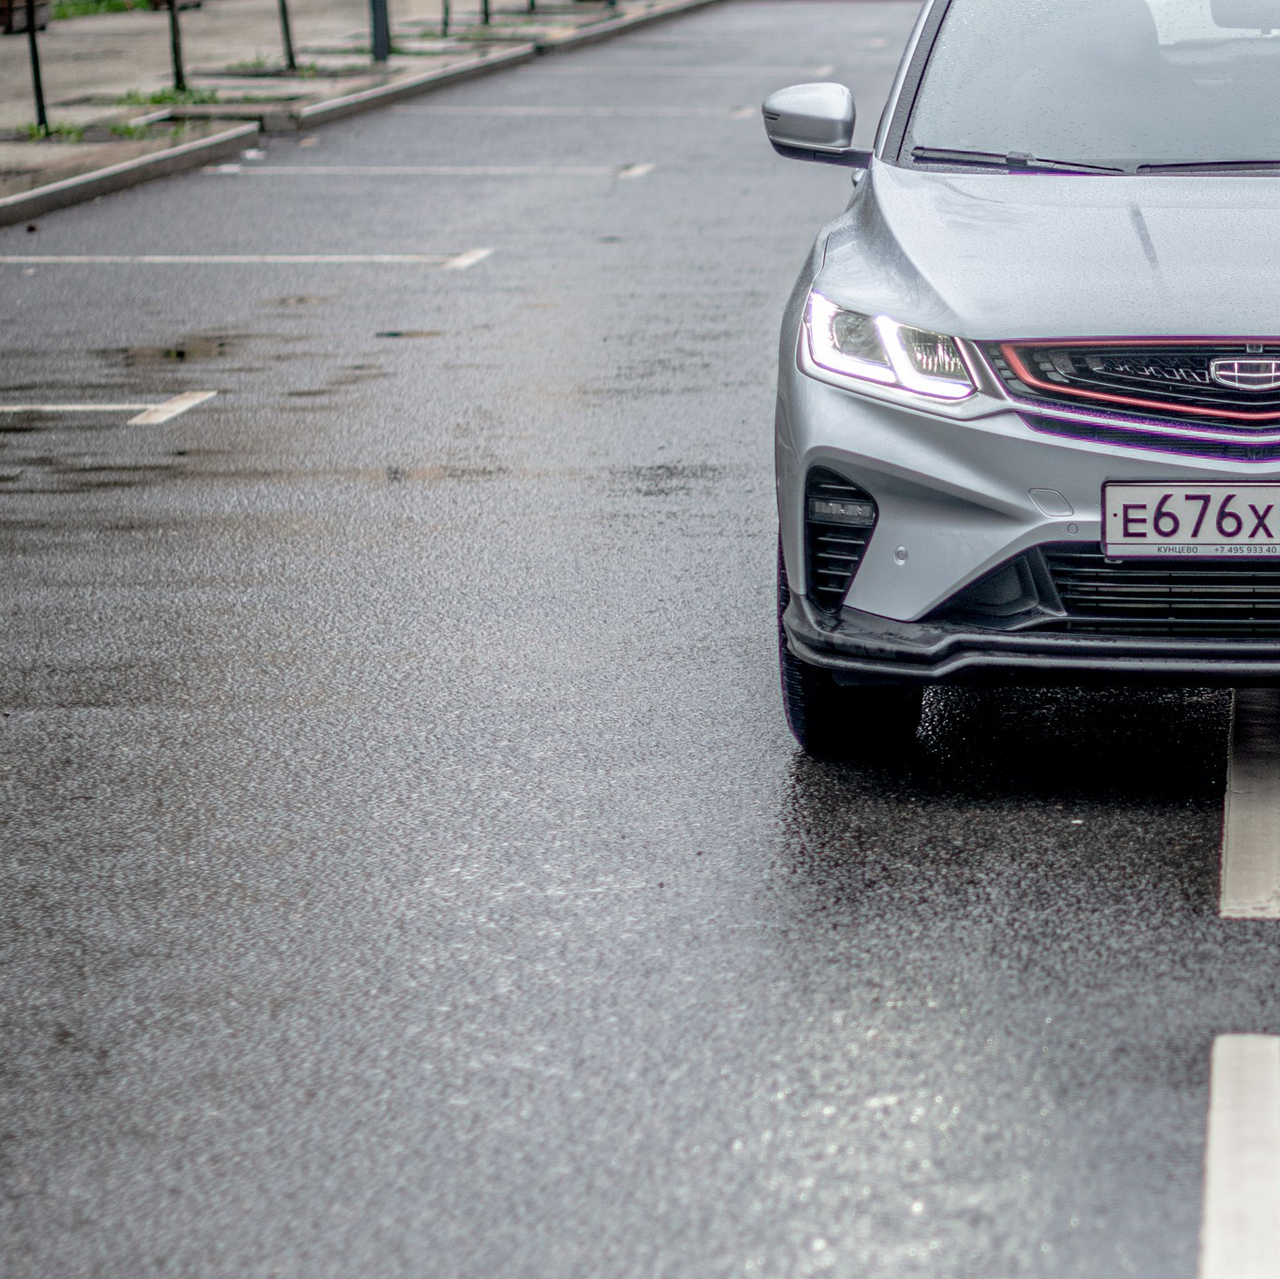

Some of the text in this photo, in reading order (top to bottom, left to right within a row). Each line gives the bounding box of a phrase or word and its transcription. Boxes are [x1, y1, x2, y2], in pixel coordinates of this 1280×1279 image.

[1157, 545, 1198, 555] КУНЦЕВО
[1213, 545, 1226, 554] +7
[1227, 545, 1244, 554] 495
[1246, 545, 1264, 554] 933
[1265, 545, 1278, 554] 40
